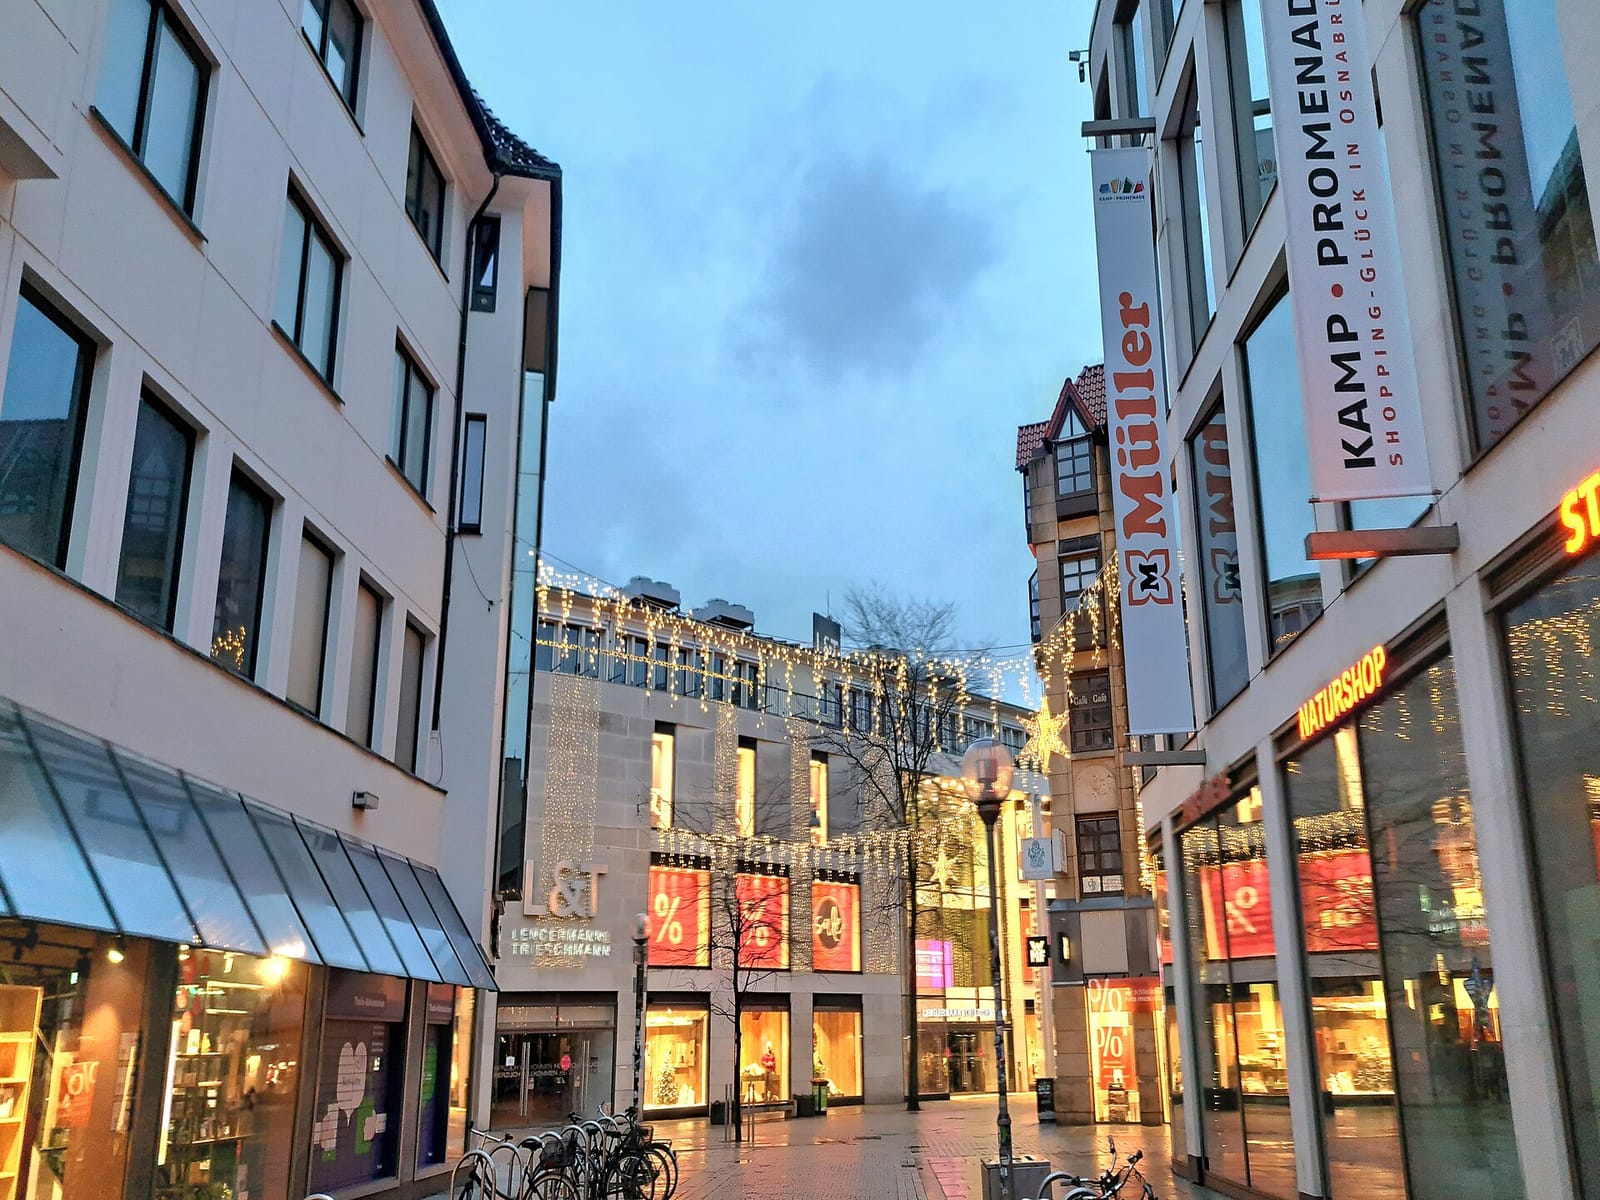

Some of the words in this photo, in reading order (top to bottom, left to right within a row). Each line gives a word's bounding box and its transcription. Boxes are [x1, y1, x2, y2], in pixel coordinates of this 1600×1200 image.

[1287, 0, 1349, 266] PROMENAD
[1346, 143, 1361, 169] IN
[1327, 313, 1376, 469] KAMP
[1352, 188, 1404, 466] SHOPPING-GLÜCK
[1112, 291, 1166, 540] Müller
[1298, 646, 1386, 738] NATURSHOP
[523, 859, 608, 918] L&T
